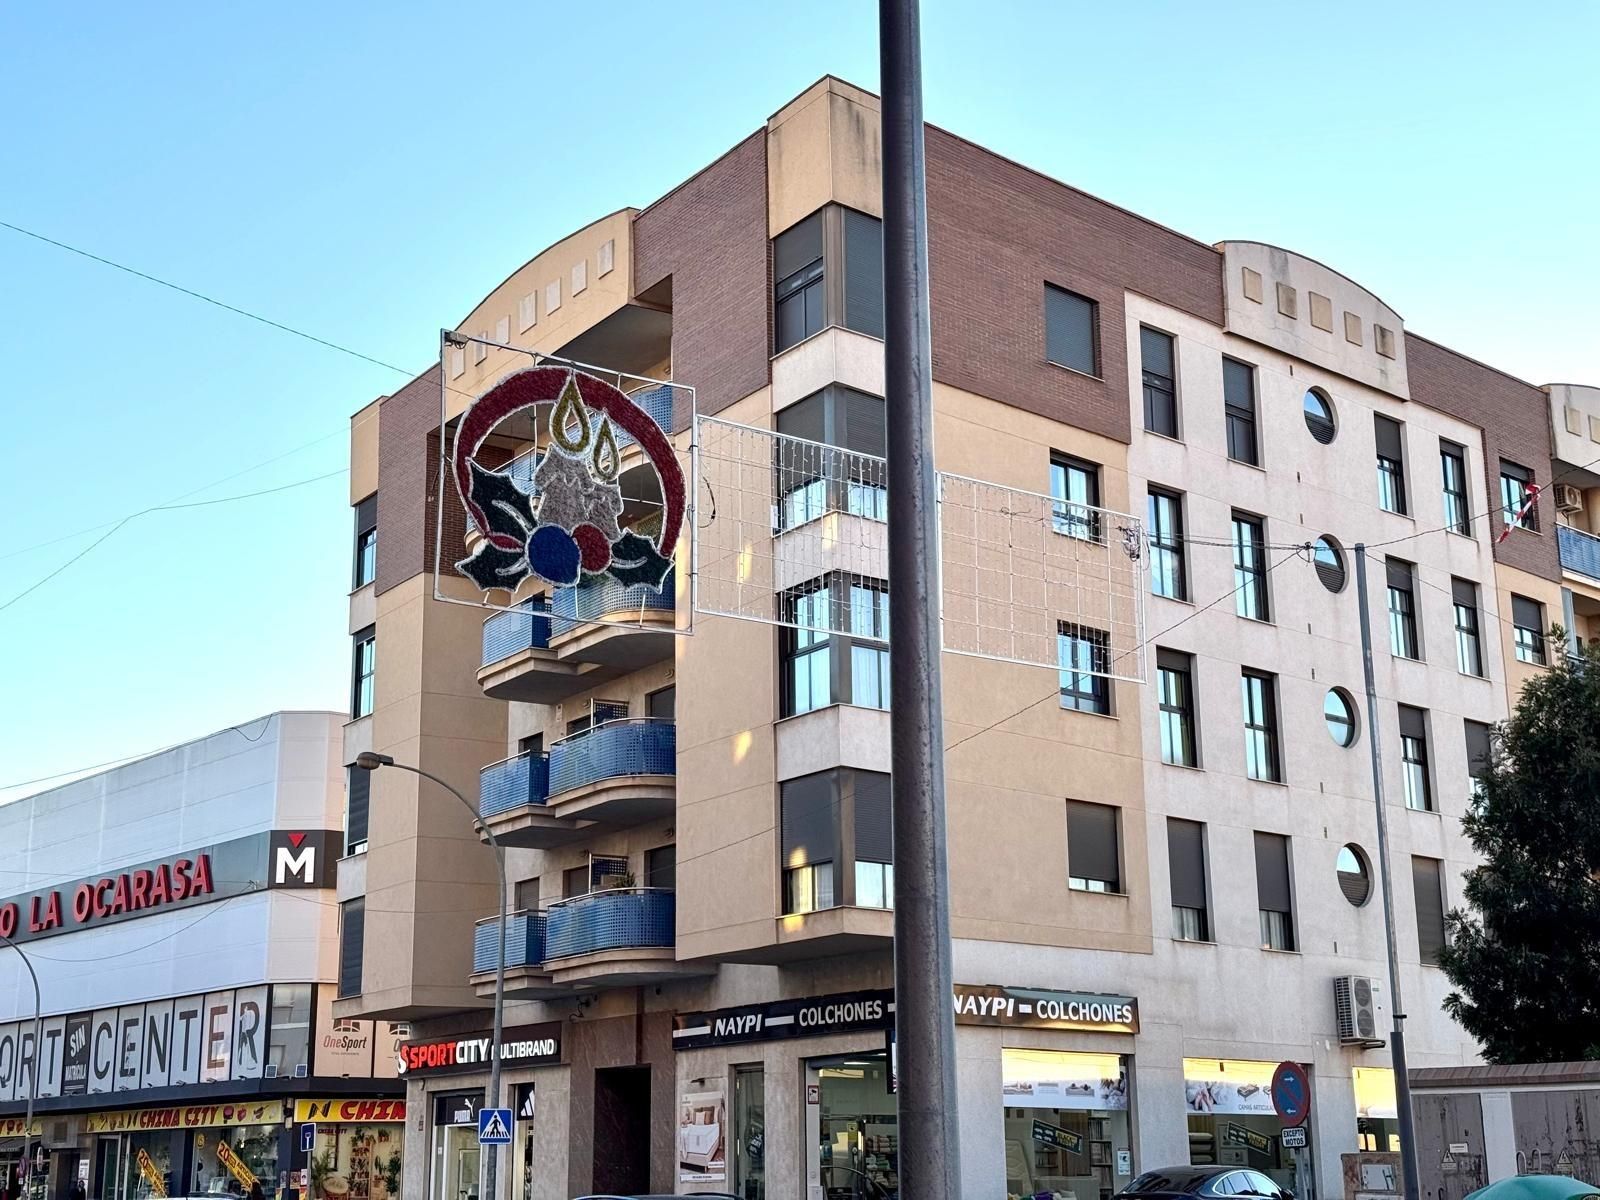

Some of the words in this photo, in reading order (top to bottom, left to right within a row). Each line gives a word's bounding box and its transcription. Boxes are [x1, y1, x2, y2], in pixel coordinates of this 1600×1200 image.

[0, 902, 18, 939] O
[28, 890, 63, 933] LA
[73, 854, 214, 924] OCARASA
[714, 1013, 763, 1037] NAYPI
[799, 999, 883, 1027] COLCHONES
[953, 993, 1015, 1017] NAYPI
[1036, 999, 1133, 1024] COLCHONES
[70, 1024, 86, 1057] SIN
[93, 1001, 261, 1080] CENTER
[323, 1035, 367, 1051] OneSport
[139, 1108, 180, 1129] CHINA
[185, 1105, 219, 1126] CITY
[1283, 1129, 1304, 1138] EXCEPTO
[1285, 1138, 1304, 1146] MOTOS
[219, 1142, 229, 1161] 20
